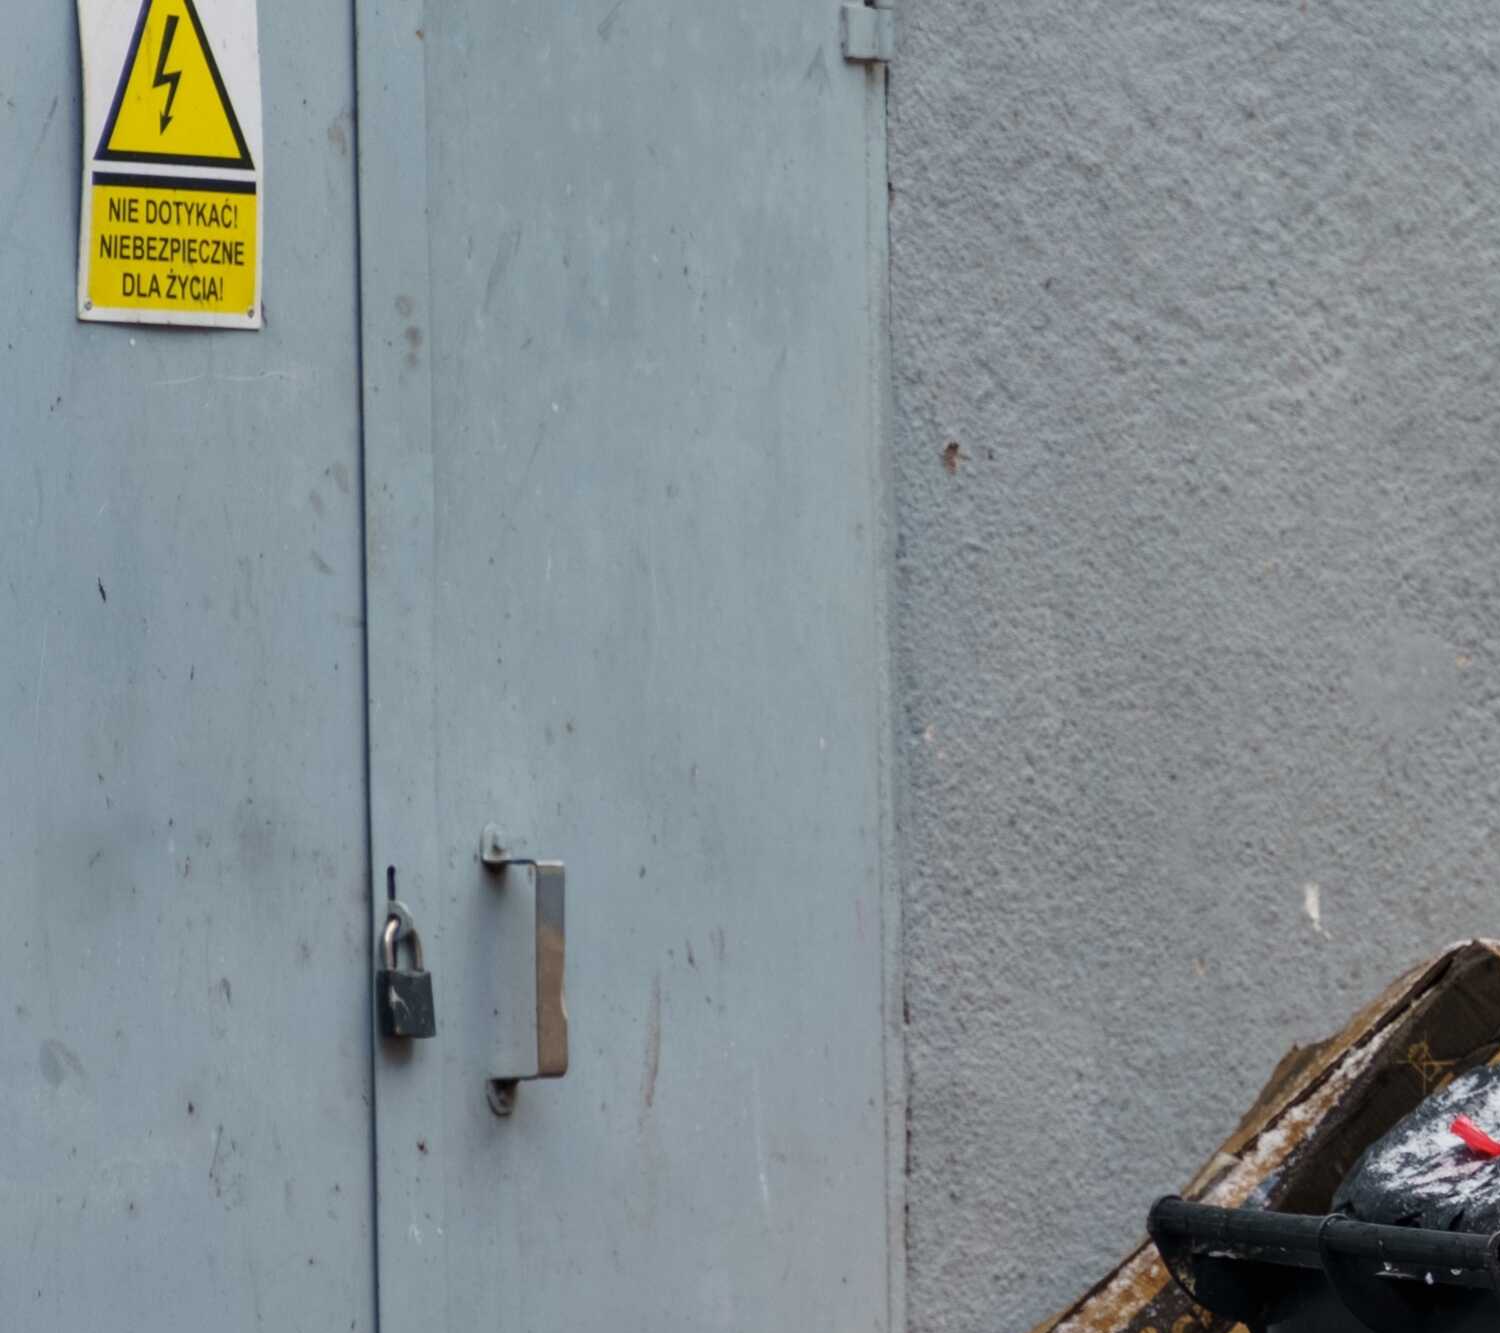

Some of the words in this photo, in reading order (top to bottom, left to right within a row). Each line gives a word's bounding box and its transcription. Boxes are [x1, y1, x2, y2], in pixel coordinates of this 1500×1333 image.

[108, 197, 139, 224] NIE
[145, 198, 238, 229] DOTYKAĆ!
[99, 233, 245, 266] NIEBEZPIECZNE
[121, 272, 162, 299] DLA
[165, 267, 224, 302] ŻYCIA!
